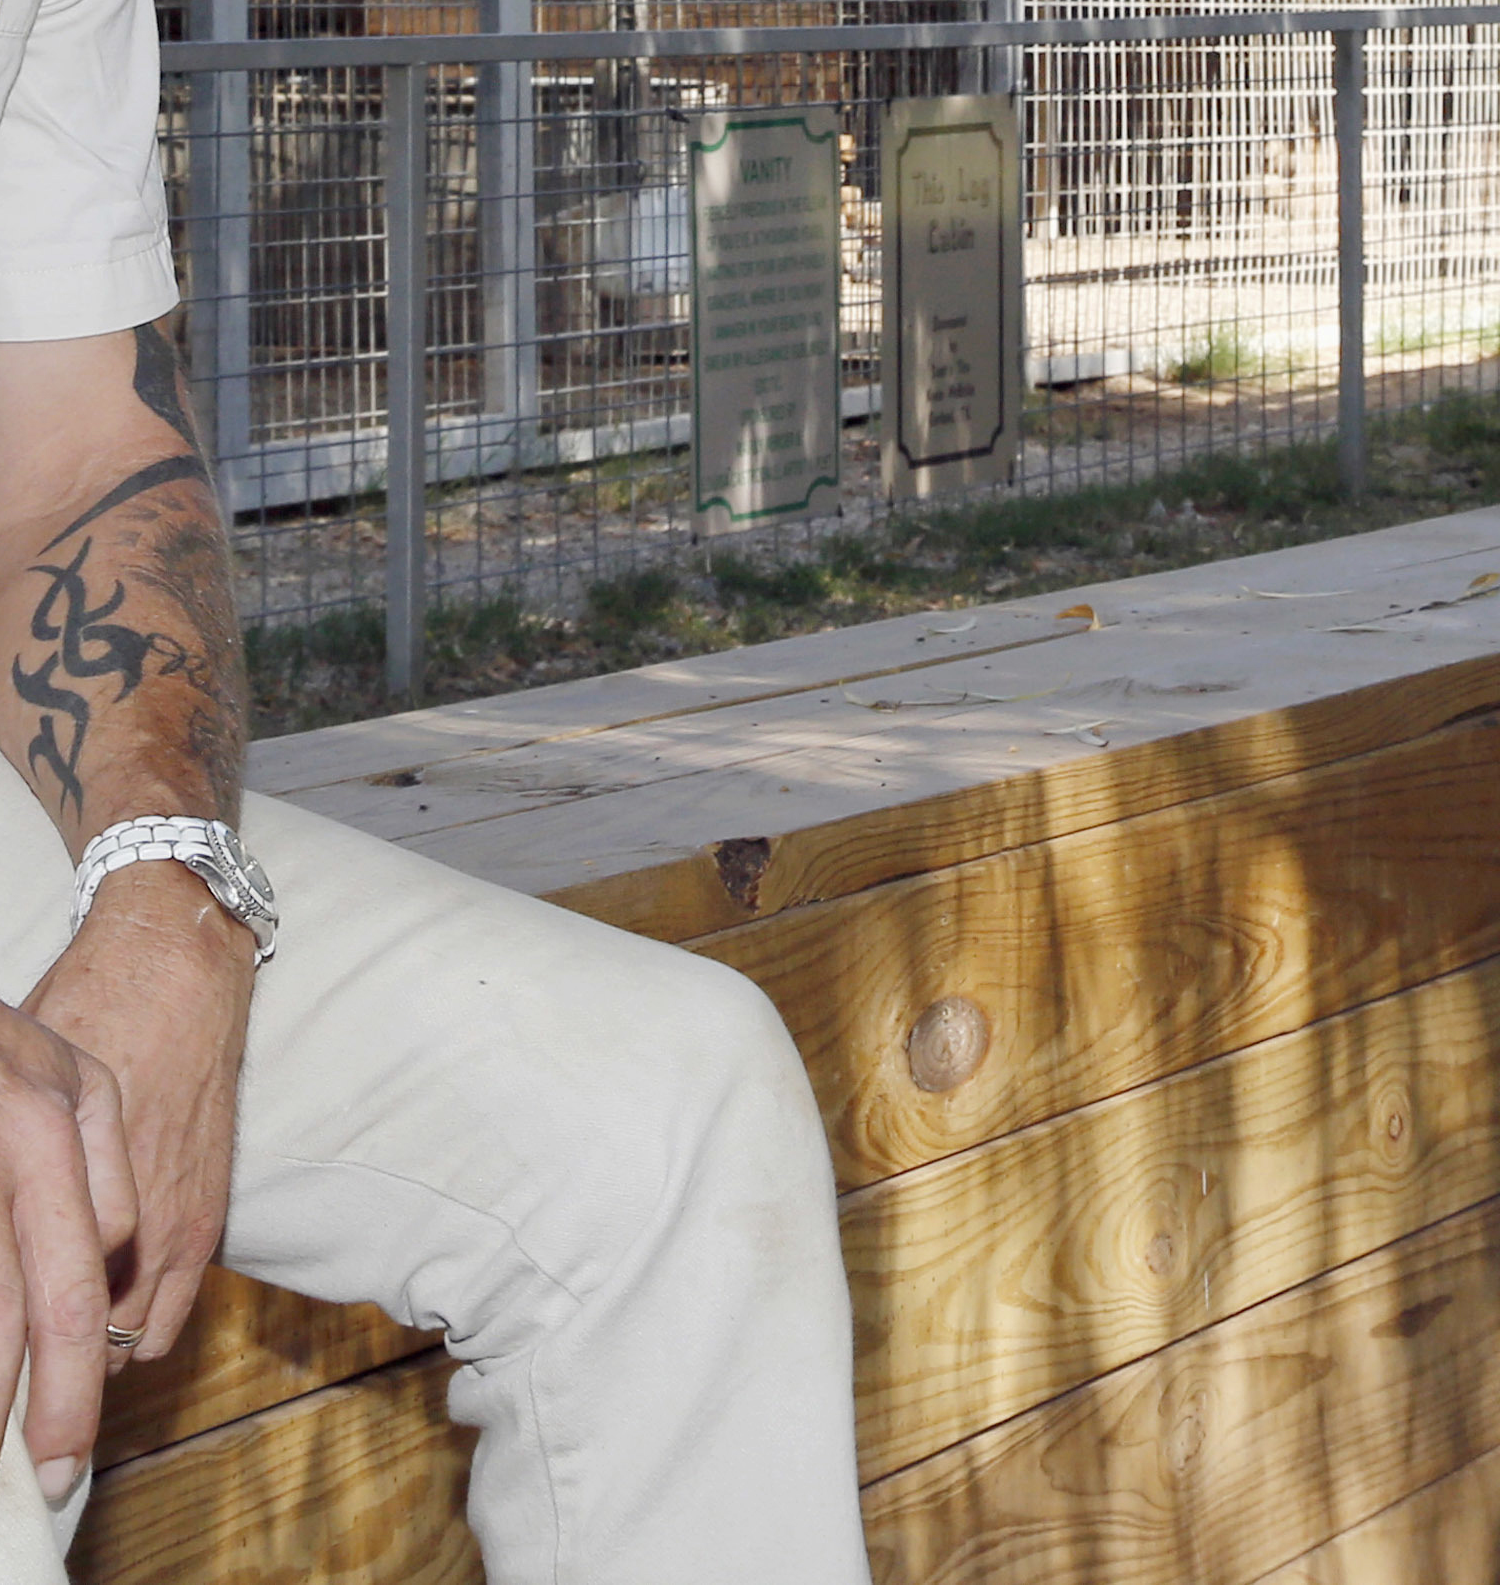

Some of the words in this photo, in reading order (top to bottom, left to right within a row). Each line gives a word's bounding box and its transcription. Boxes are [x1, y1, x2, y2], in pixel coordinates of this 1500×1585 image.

[740, 156, 792, 184] VANITY
[911, 170, 945, 205] This
[956, 166, 992, 208] Log
[927, 217, 975, 254] Cabin
